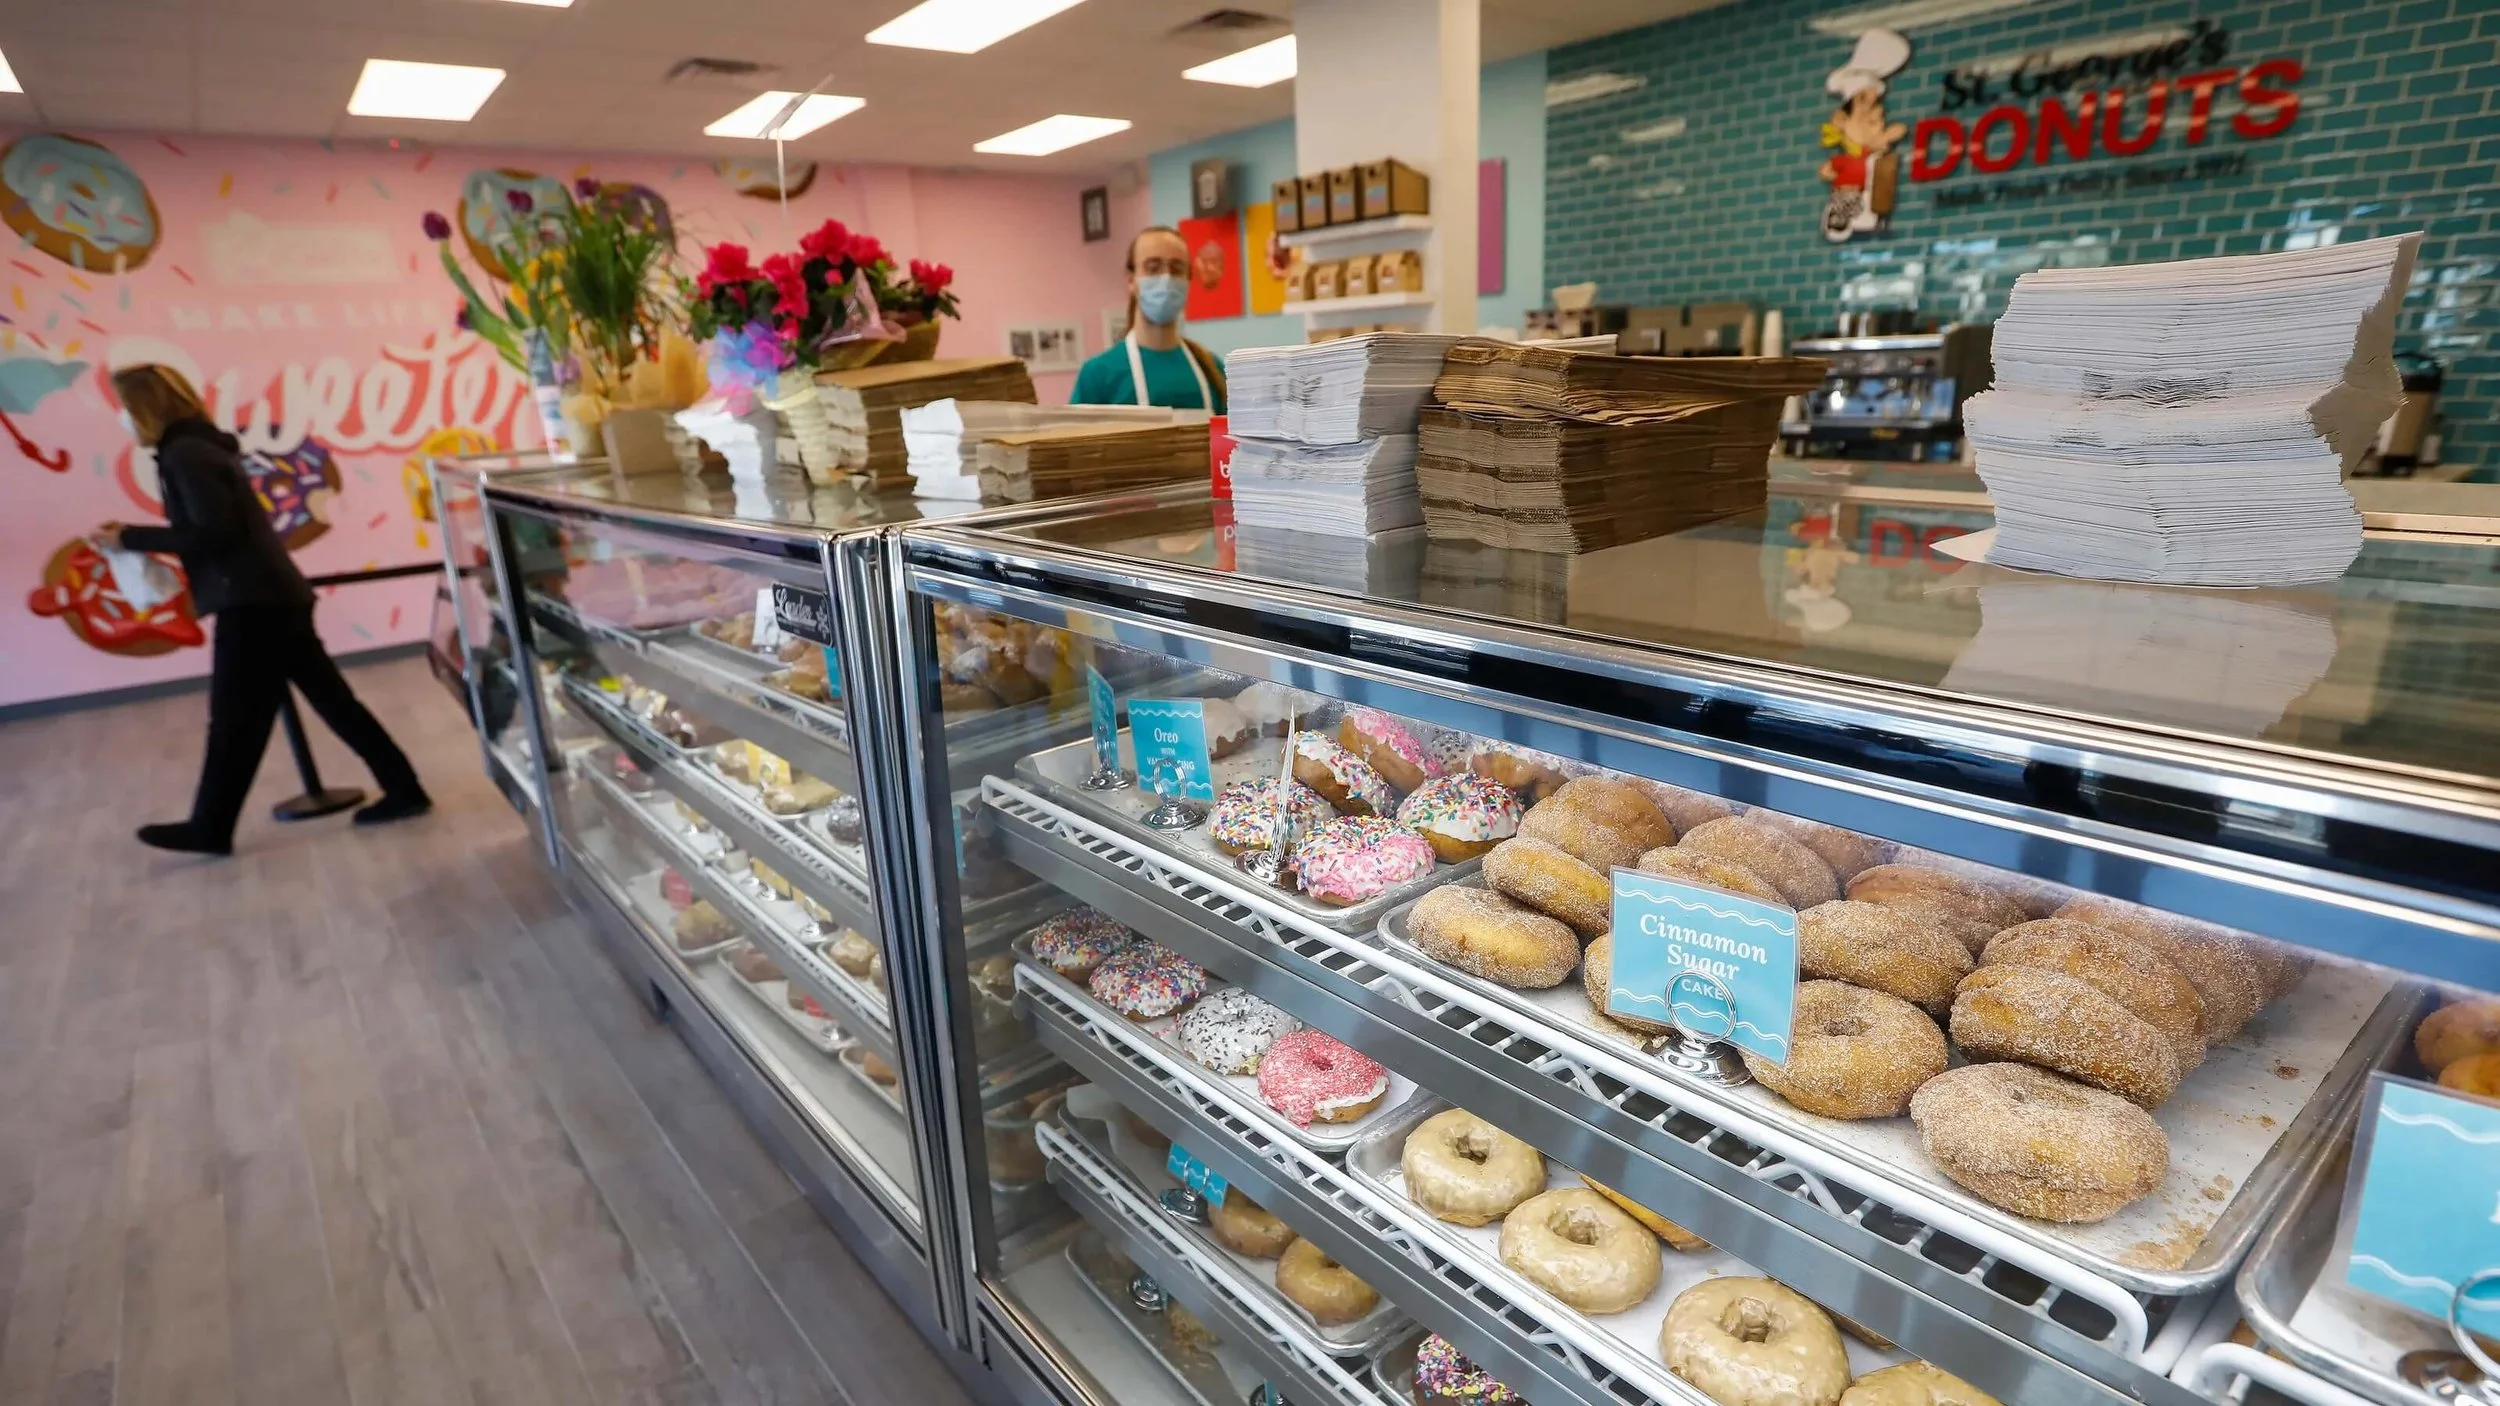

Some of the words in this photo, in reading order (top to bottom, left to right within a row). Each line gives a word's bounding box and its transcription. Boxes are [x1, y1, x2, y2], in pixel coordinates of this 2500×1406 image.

[1940, 68, 1998, 111] St.
[2009, 18, 2232, 99] George's
[1909, 58, 2305, 182] DONUTS
[169, 302, 323, 331] MAKE
[1154, 727, 1179, 744] Oreo
[1640, 913, 1768, 965] Cinnamon
[1667, 943, 1740, 981] Sugar
[1681, 979, 1725, 1001] CAKE
